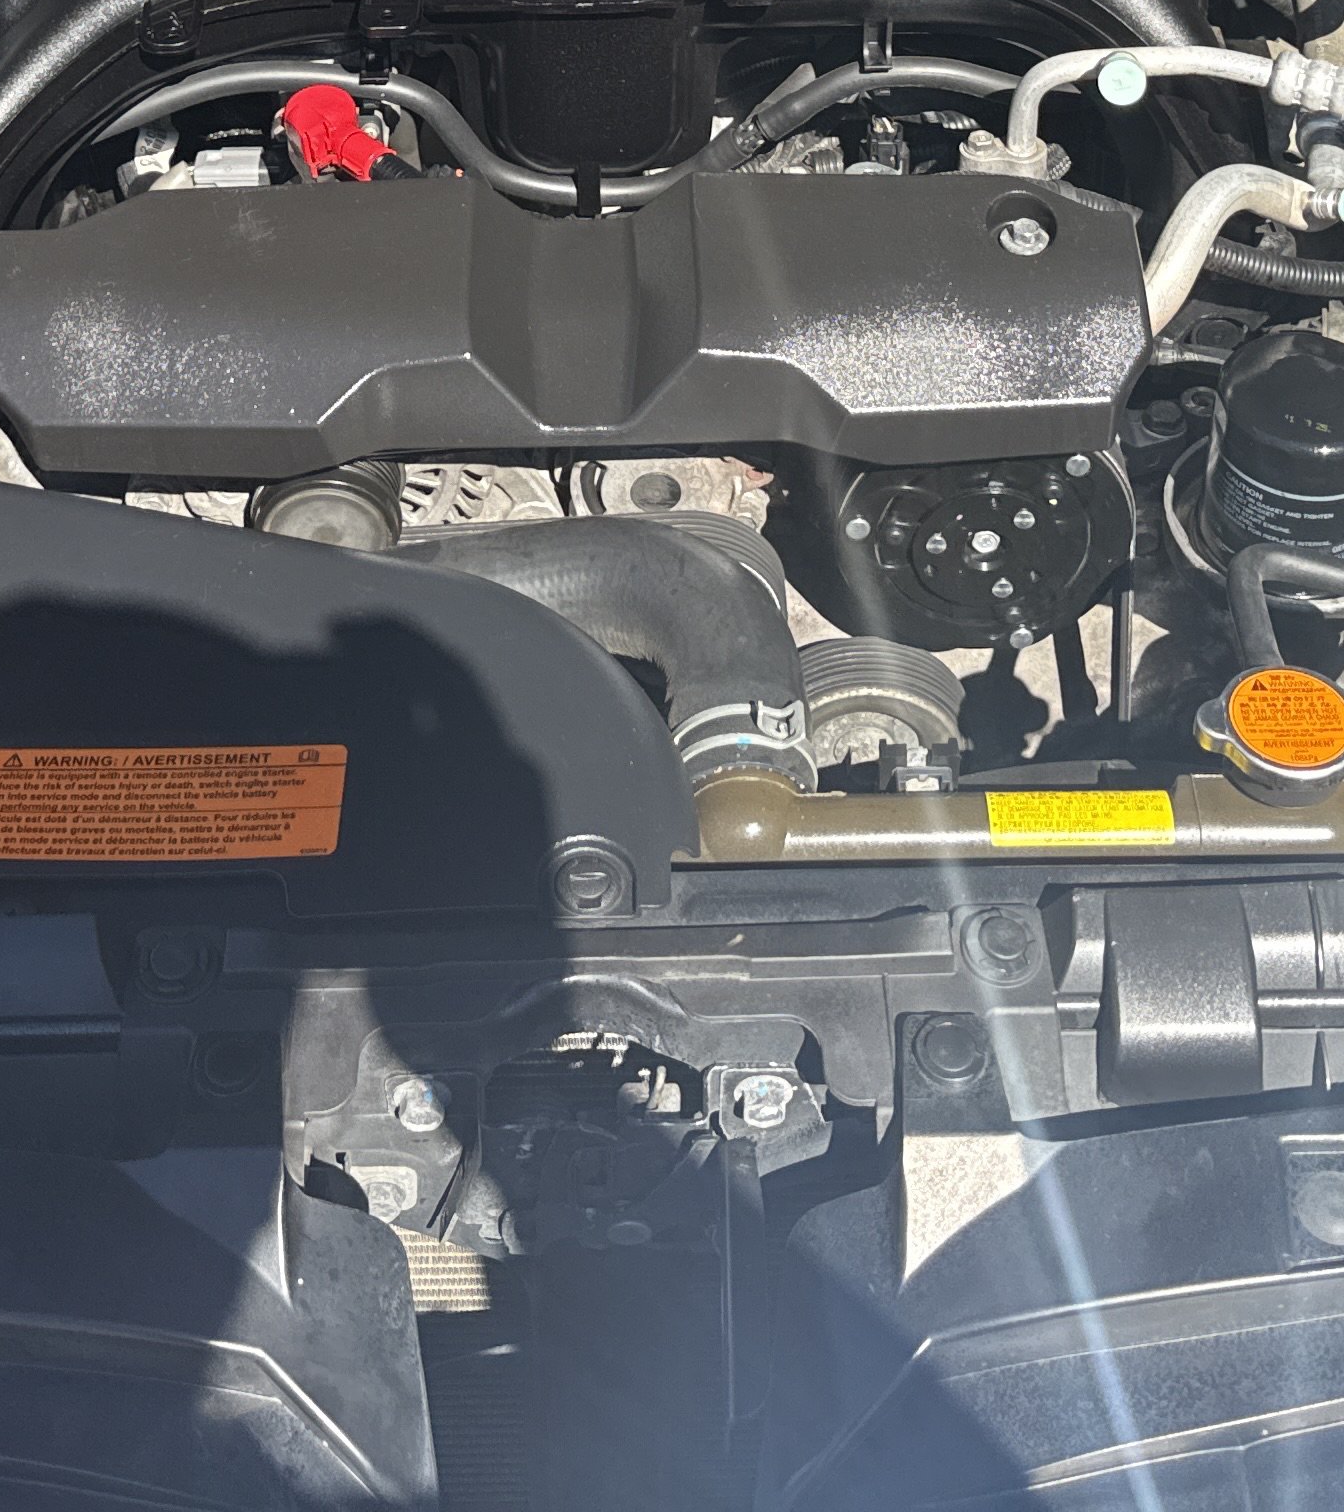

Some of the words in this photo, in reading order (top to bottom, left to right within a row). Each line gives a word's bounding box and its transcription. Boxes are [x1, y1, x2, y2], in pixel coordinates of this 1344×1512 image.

[1225, 471, 1264, 501] CAUTION
[1255, 500, 1285, 515] GASKET
[1286, 511, 1302, 519] AND
[1303, 512, 1334, 520] TIGHTEN
[122, 755, 129, 766] /
[133, 752, 272, 766] AVERTISSEMENT
[48, 772, 96, 781] equipped
[132, 771, 168, 779] remote
[171, 770, 223, 778] controlled
[225, 770, 259, 778] engine
[23, 782, 39, 790] the
[42, 782, 61, 790] risk
[64, 782, 75, 790] of
[78, 782, 116, 790] serious
[118, 782, 147, 791] injury
[235, 780, 269, 789] engine
[272, 778, 306, 787] starter
[124, 792, 181, 800] disconnect
[184, 791, 201, 799] the
[203, 790, 239, 799] vehicle
[242, 790, 278, 798] battery
[0, 803, 57, 813] performing
[61, 804, 79, 813] any
[25, 815, 41, 823] est
[44, 815, 67, 823] doté
[72, 814, 95, 823] d'un
[98, 814, 153, 823] démarreur
[155, 814, 161, 822] à
[213, 813, 239, 821] Pour
[241, 812, 278, 821] réduire
[0, 826, 14, 834] de
[16, 826, 67, 834] blessures
[70, 827, 105, 835] graves
[179, 825, 213, 833] mettre
[227, 822, 282, 832] démarreur
[284, 822, 291, 830] à
[19, 836, 49, 844] mode
[105, 836, 166, 845] débrancher
[168, 836, 177, 844] la
[180, 835, 220, 844] batterie
[223, 834, 236, 842] du
[239, 833, 283, 842] véhicule
[44, 847, 63, 855] des
[67, 847, 105, 855] travaux
[108, 847, 165, 856] d'entretien
